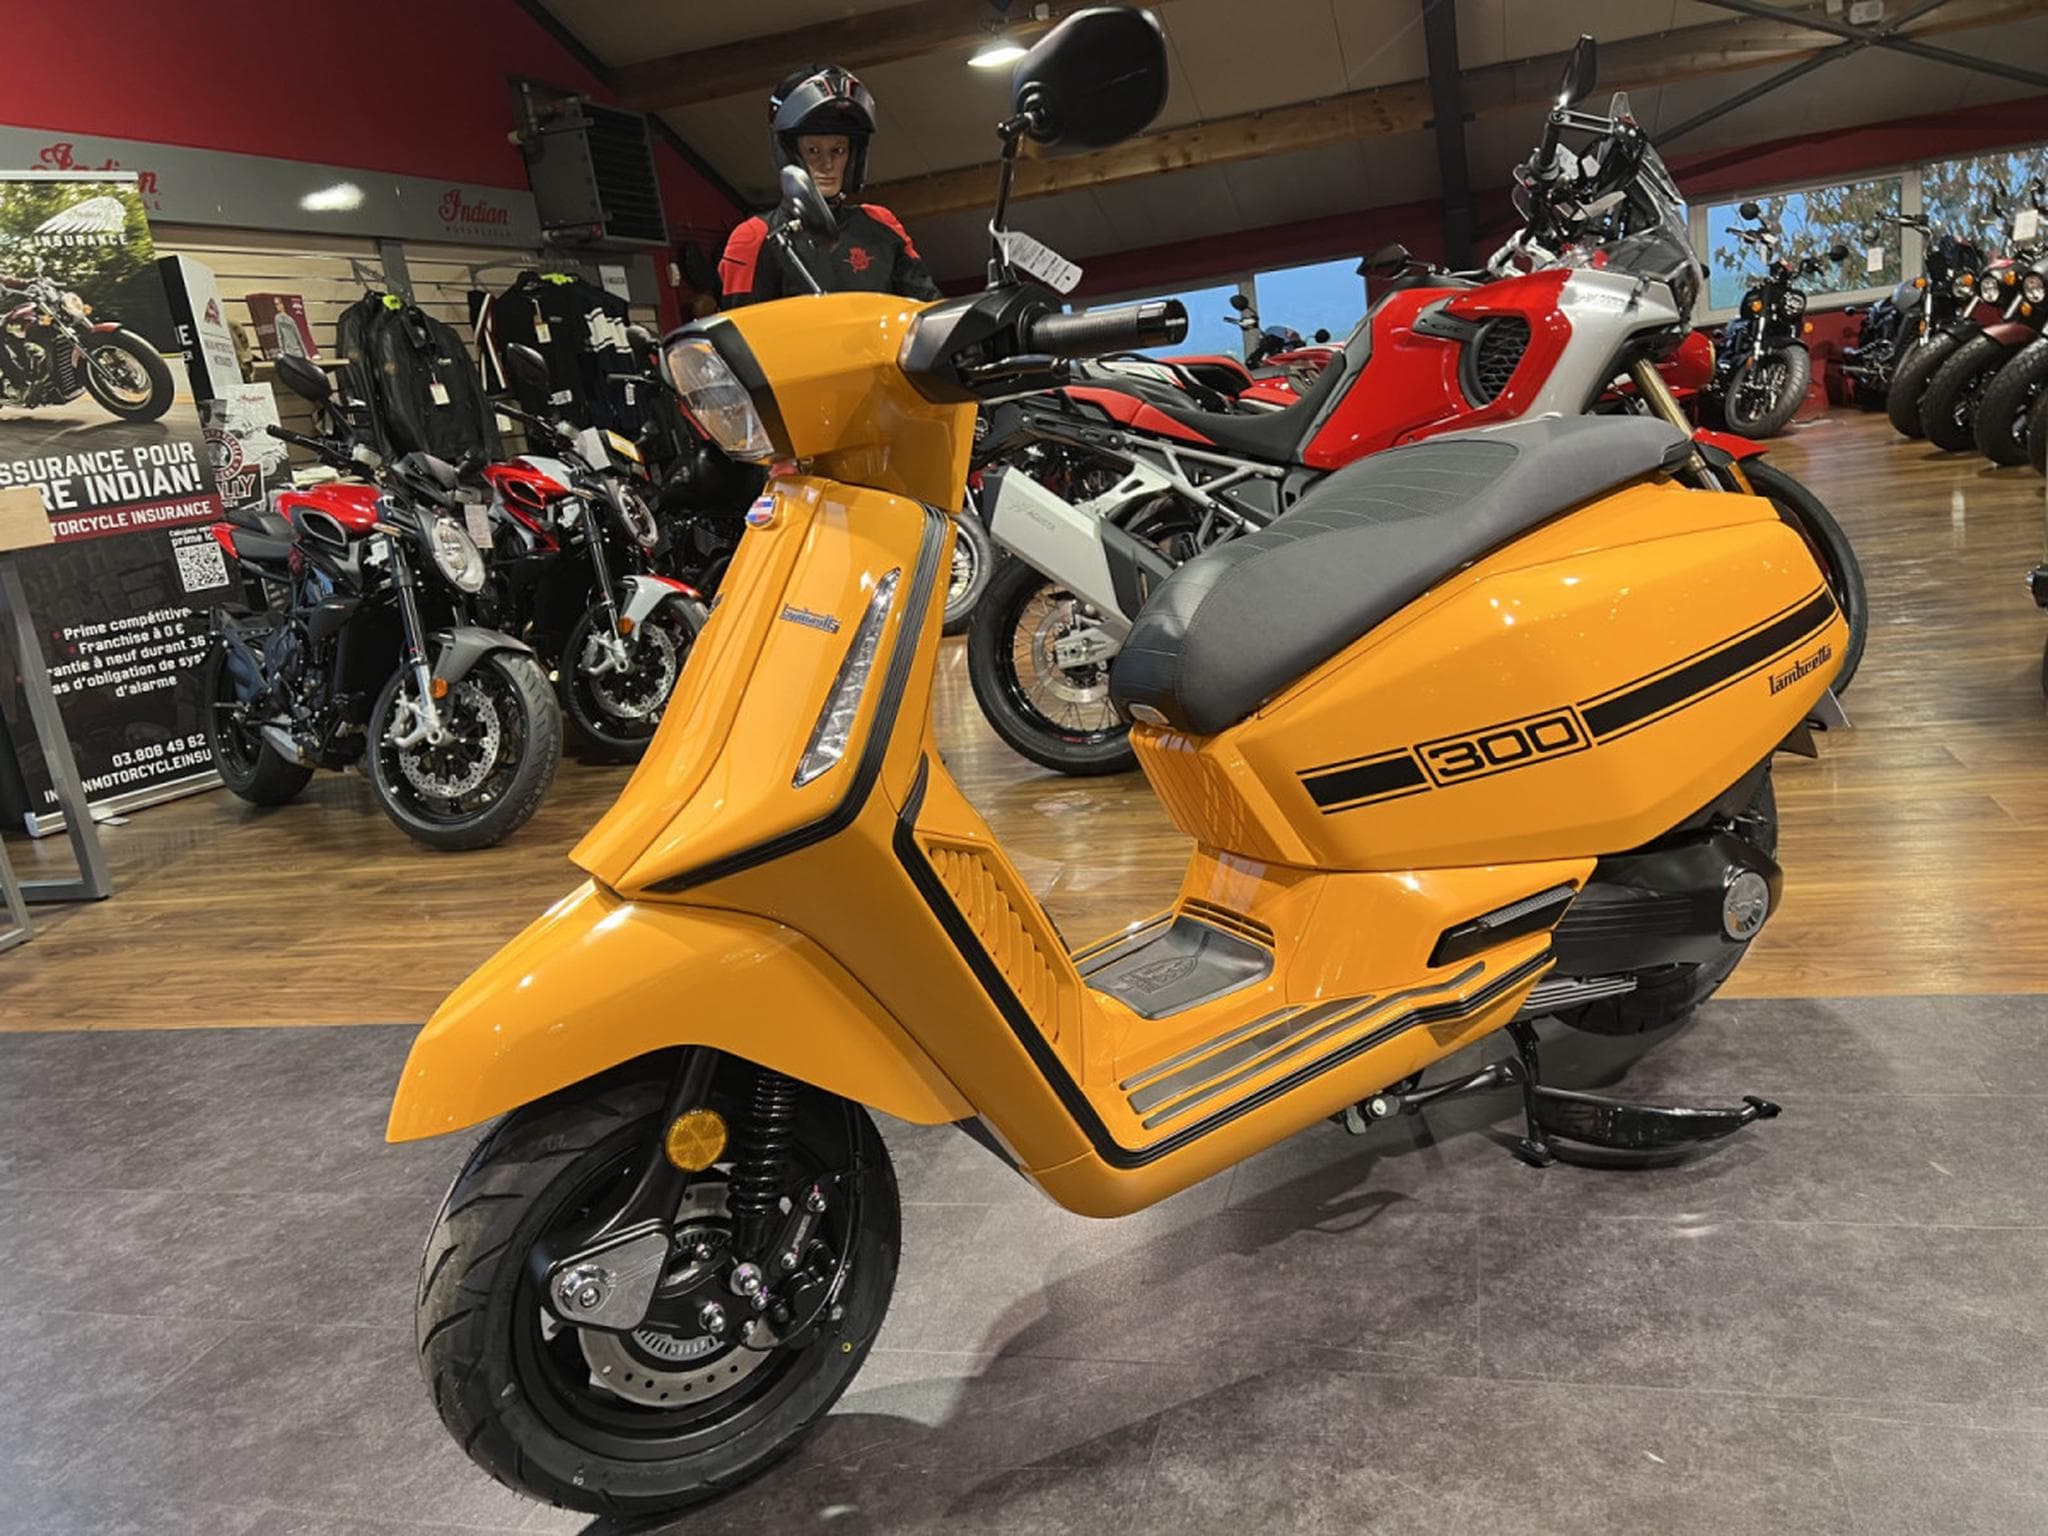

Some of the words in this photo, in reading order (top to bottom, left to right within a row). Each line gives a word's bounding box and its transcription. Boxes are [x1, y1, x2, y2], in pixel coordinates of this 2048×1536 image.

[438, 188, 510, 226] Indian
[34, 233, 129, 248] INSURANCE
[132, 442, 197, 473] POUR
[84, 463, 203, 505] INDIAN!
[51, 512, 129, 537] TORCYCLE
[132, 500, 213, 525] INSURANCE
[63, 623, 107, 640] Prime
[109, 607, 191, 630] compétitive
[78, 633, 150, 654] Franchise
[152, 627, 163, 641] à
[175, 623, 185, 636] €
[46, 658, 90, 677] antie
[93, 655, 103, 669] à
[105, 648, 138, 667] neuf
[140, 642, 187, 659] durant
[188, 635, 206, 648] 36
[51, 682, 71, 695] as
[73, 663, 157, 690] d'obligation
[158, 657, 177, 671] de
[115, 674, 178, 698] d'alarme
[1427, 715, 1581, 778] 300
